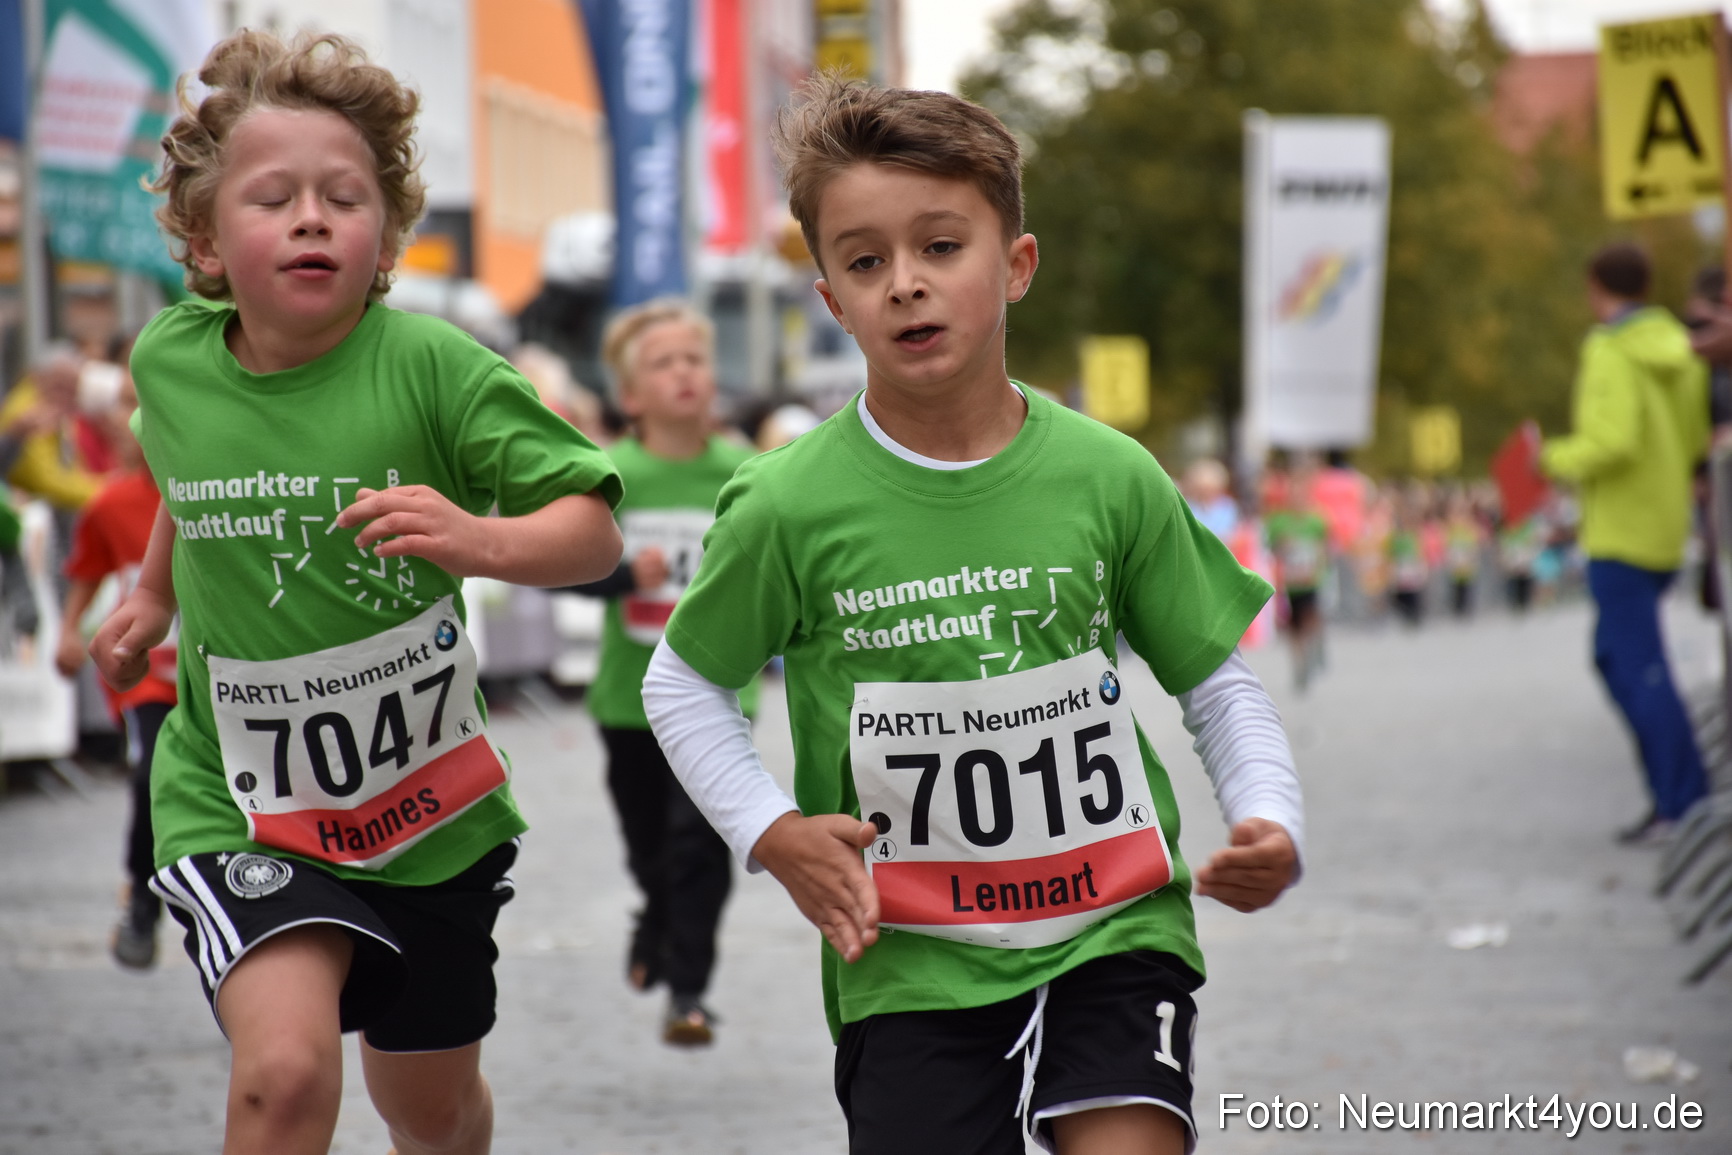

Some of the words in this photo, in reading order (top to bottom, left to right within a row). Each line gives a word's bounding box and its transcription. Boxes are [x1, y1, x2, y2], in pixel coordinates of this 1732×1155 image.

[1636, 74, 1705, 165] A
[168, 470, 320, 502] Neumarkter
[173, 508, 286, 541] tadtlauf
[833, 566, 1032, 616] Neumarkter
[842, 604, 996, 651] Stadtlauf
[216, 681, 300, 704] PARTL
[303, 642, 431, 699] Neumarkt
[244, 663, 456, 799] 7047
[458, 720, 473, 736] K
[858, 712, 956, 737] PARTL
[962, 687, 1092, 734] Neumarkt
[249, 798, 257, 811] 4
[885, 720, 1124, 848] 7015
[317, 787, 441, 853] Hannes
[1130, 806, 1144, 825] K
[879, 841, 890, 858] 4
[950, 861, 1098, 913] Lennart
